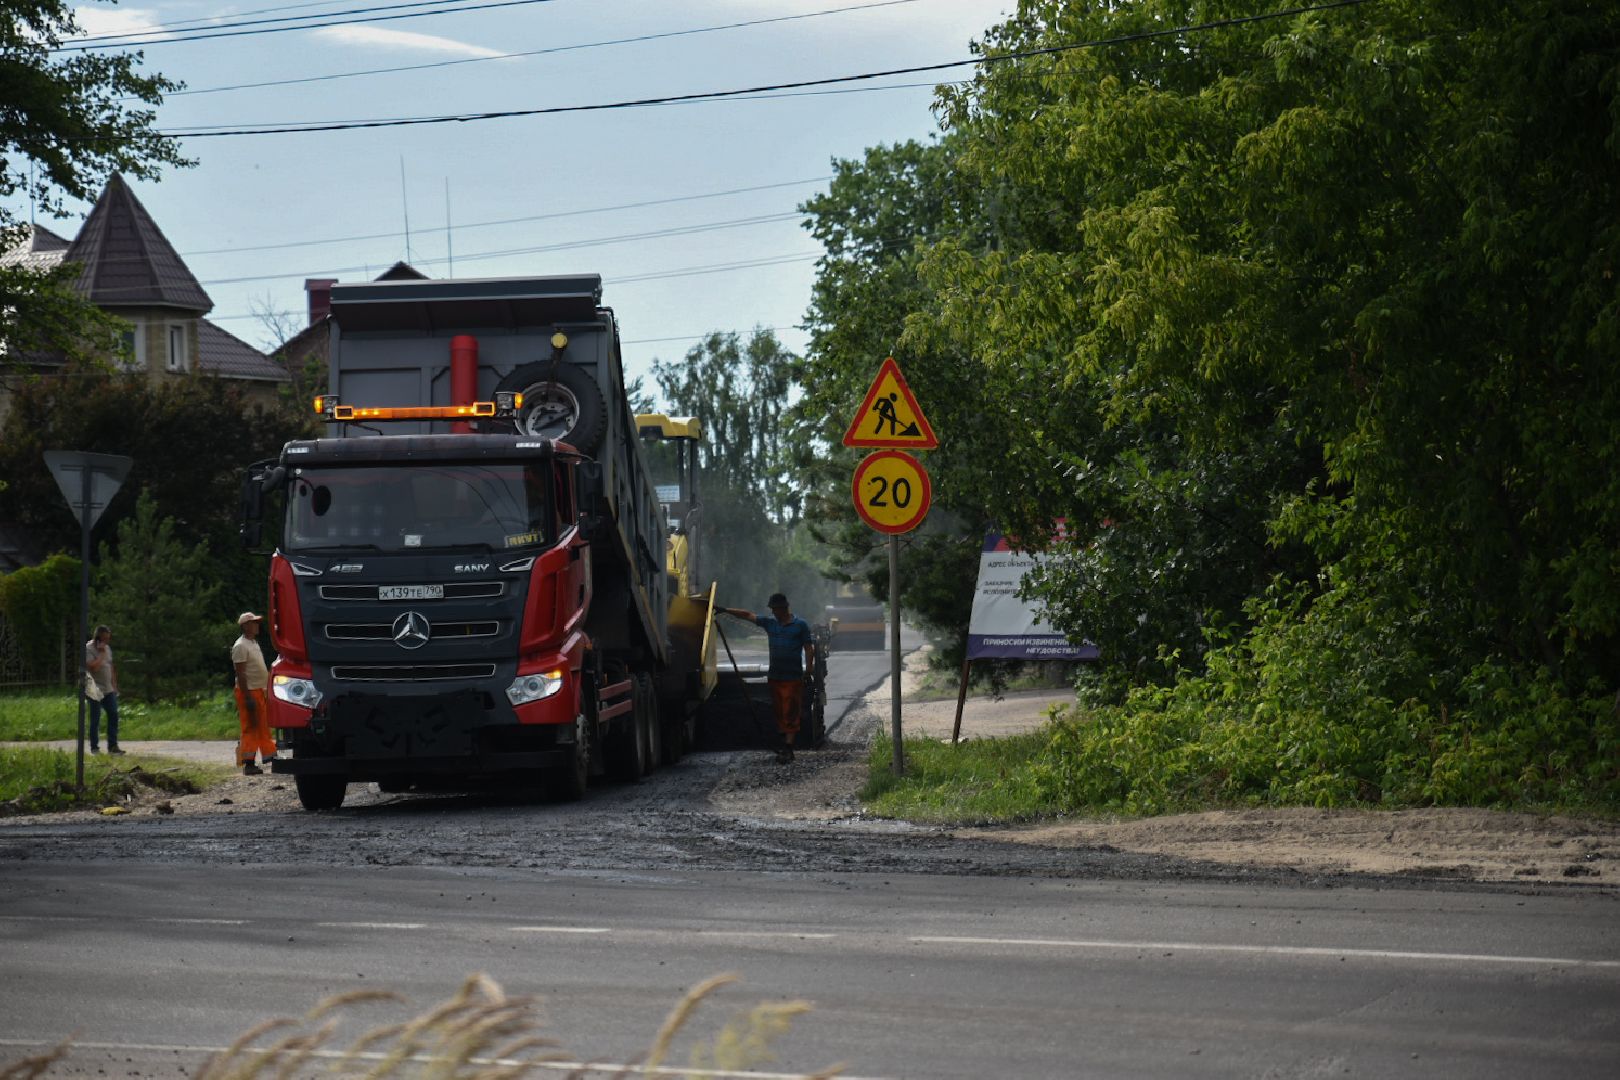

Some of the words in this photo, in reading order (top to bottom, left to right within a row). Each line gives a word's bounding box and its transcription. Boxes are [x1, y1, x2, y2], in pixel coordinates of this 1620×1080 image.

[869, 476, 911, 508] 20
[454, 563, 489, 573] SANY
[983, 638, 1025, 646] ПРИНОСИМ
